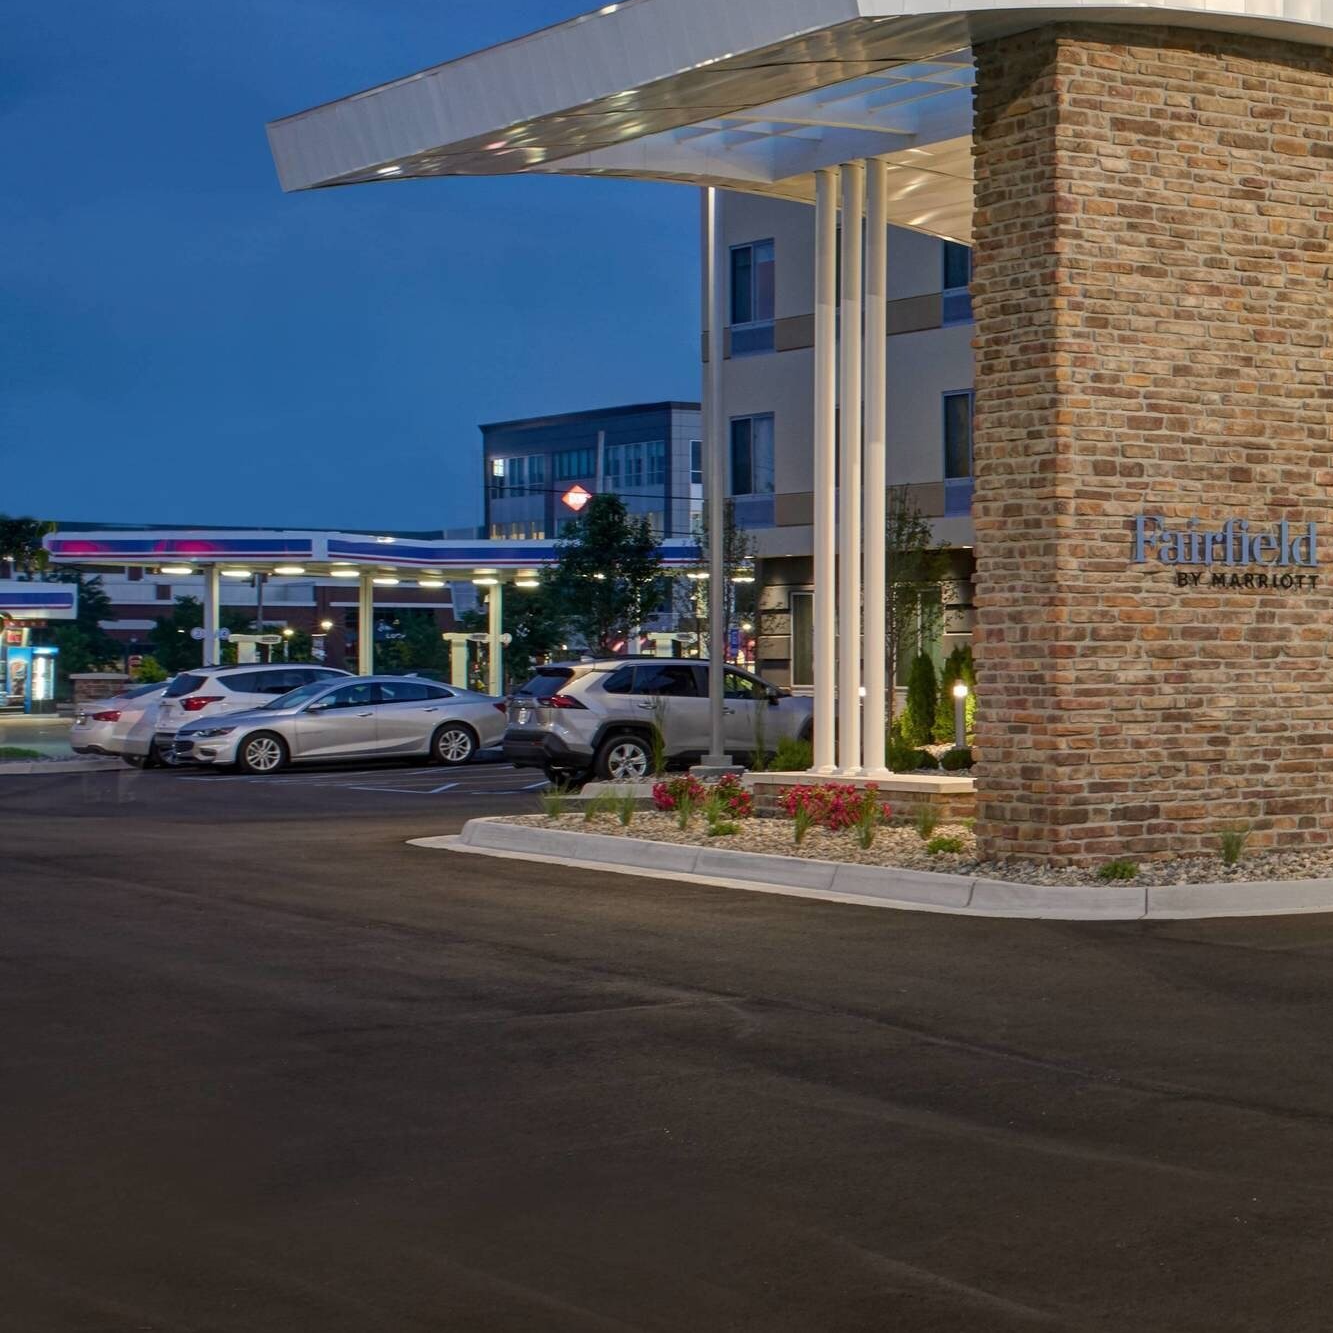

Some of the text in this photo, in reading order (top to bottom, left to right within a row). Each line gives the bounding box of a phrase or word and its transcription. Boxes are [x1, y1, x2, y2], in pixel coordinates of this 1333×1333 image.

[1132, 514, 1319, 568] Fairfield
[1177, 572, 1320, 590] BY MARRIOTT
